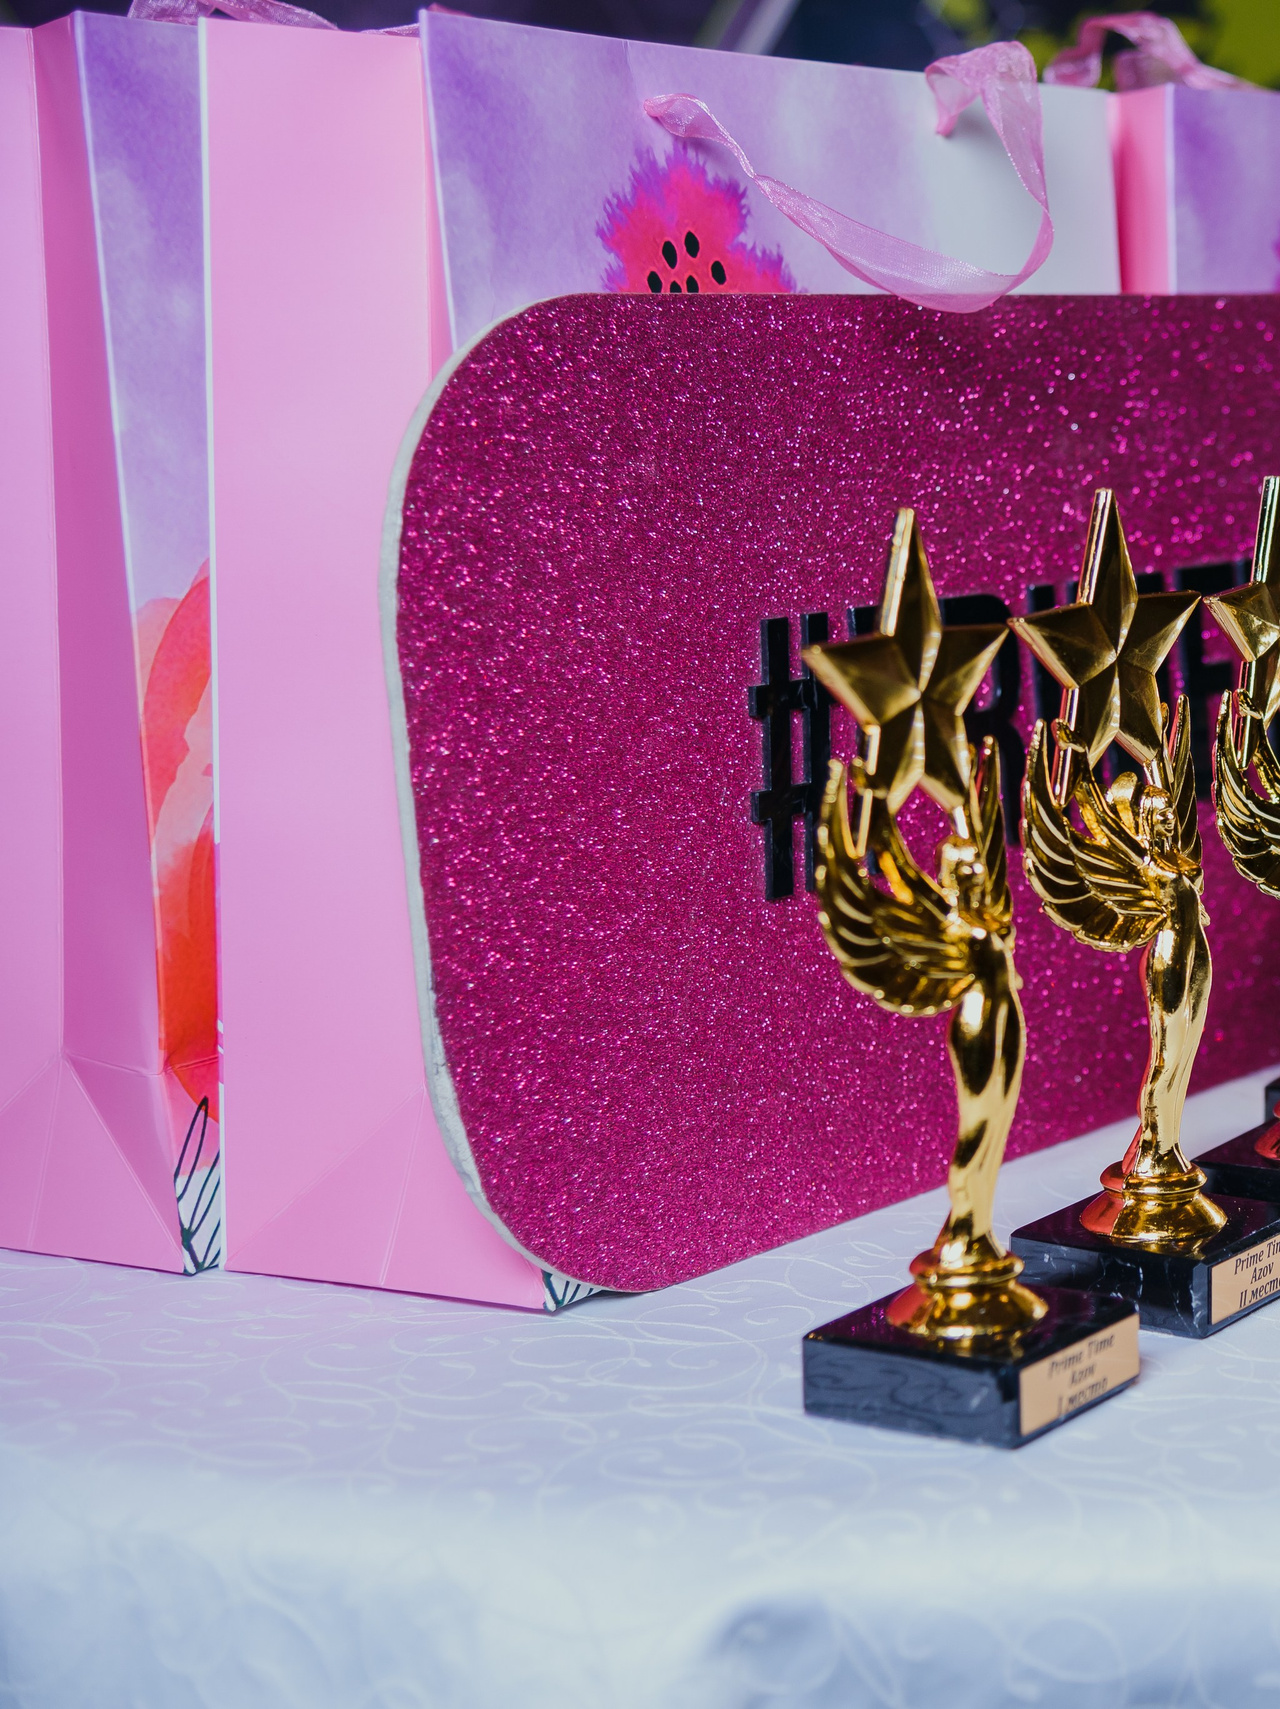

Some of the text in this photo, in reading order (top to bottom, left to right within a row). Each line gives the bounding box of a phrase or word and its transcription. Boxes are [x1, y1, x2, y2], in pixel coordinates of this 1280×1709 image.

[1234, 1250, 1264, 1275] Prime
[1250, 1262, 1275, 1285] Azov
[1238, 1289, 1248, 1309] II
[1087, 1334, 1115, 1359] Time
